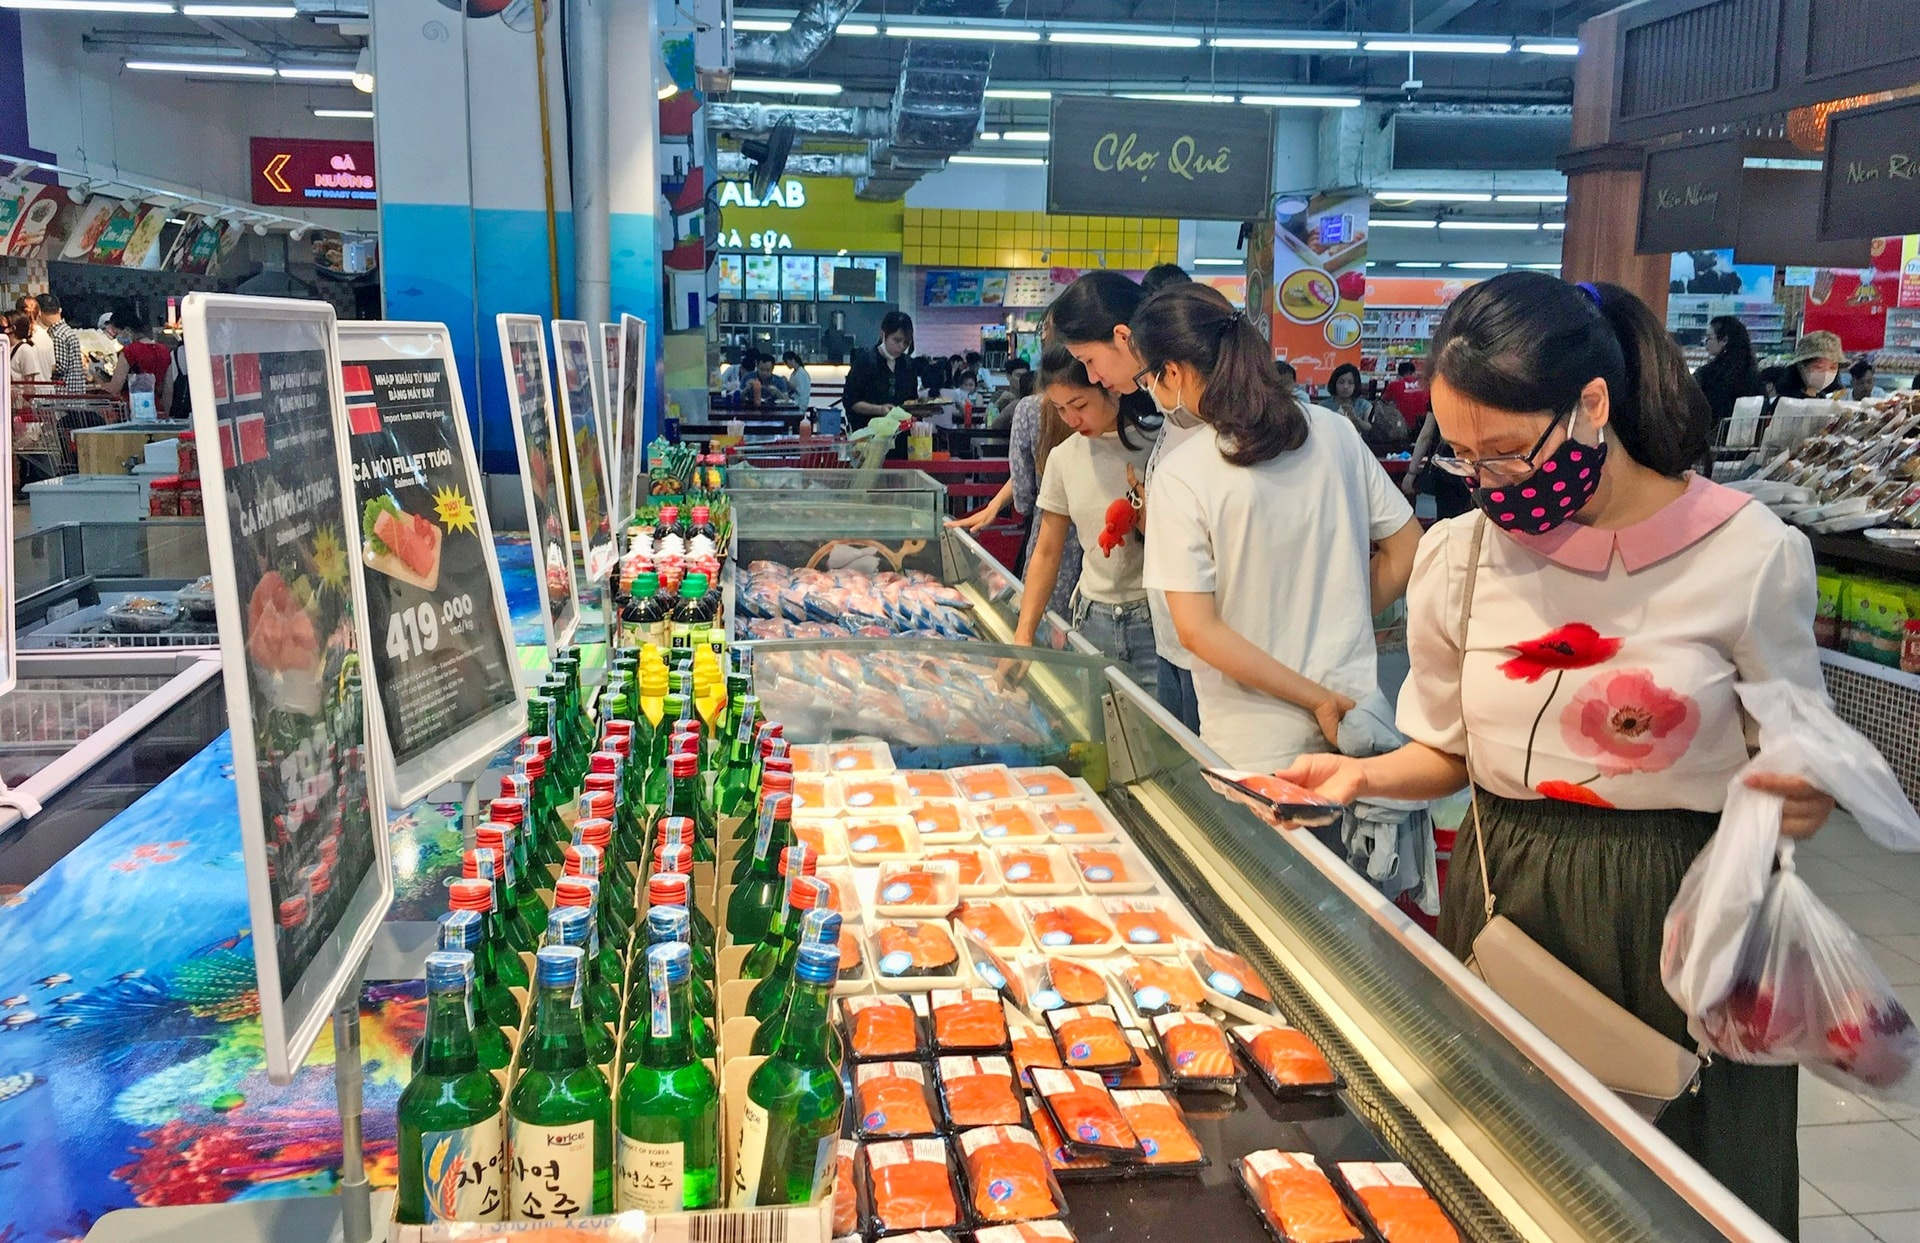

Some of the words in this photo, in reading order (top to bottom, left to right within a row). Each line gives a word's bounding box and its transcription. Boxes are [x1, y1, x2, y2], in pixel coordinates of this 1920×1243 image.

[1093, 132, 1160, 183] Chợ
[1168, 135, 1232, 180] Quê
[421, 387, 434, 399] BAY
[352, 458, 371, 482] CÁ
[393, 452, 427, 475] FILLET
[385, 601, 439, 663] 419
[521, 1191, 581, 1220] 소주
